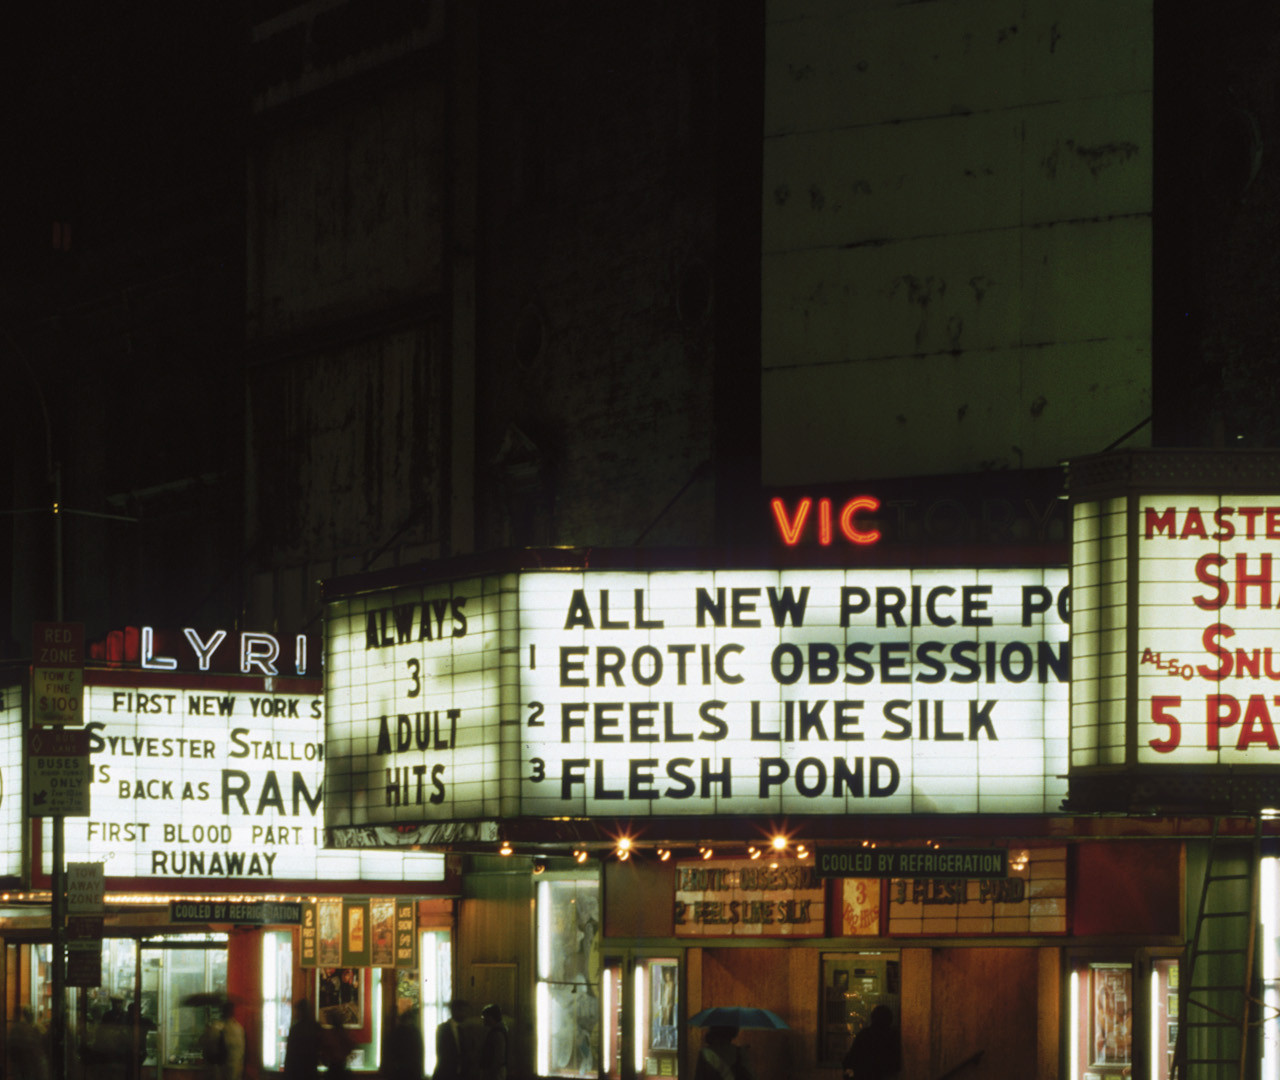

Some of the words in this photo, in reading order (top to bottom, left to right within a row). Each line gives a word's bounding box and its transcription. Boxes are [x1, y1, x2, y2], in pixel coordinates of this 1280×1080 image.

[564, 587, 665, 630] ALL
[695, 585, 811, 629] NEW
[840, 584, 994, 628] PRICE
[45, 629, 72, 643] RED
[367, 597, 468, 652] ALWAYS
[40, 649, 77, 663] ZONE
[529, 644, 536, 670] 1
[560, 644, 745, 687] EROTIC
[771, 641, 1069, 684] OBSESSION
[1140, 647, 1194, 682] ALSO
[42, 672, 63, 681] TOW
[46, 684, 70, 693] FINE
[406, 657, 421, 698] 3
[39, 697, 78, 711] $100
[112, 692, 175, 715] FIRST
[188, 693, 235, 717] NEW
[249, 696, 300, 719] YORK
[377, 708, 461, 757] ADULT
[527, 702, 544, 727] 2
[561, 701, 728, 743] FEELS
[750, 700, 864, 742] LIKE
[881, 699, 999, 741] SILK
[1149, 697, 1181, 753] 5
[86, 721, 215, 758] SYLVESTER
[38, 758, 79, 769] BUSES
[50, 778, 82, 787] ONLY
[386, 764, 447, 808] HITS
[528, 758, 545, 783] 3
[561, 758, 733, 801] FLESH
[759, 757, 900, 799] POND
[118, 780, 172, 800] BACK
[181, 782, 209, 801] AS
[221, 769, 323, 816] RAM
[87, 822, 148, 843] FIRST
[163, 823, 231, 844] BLOOD
[251, 825, 303, 845] PART
[76, 868, 96, 877] TOW
[151, 850, 277, 876] RUNAWAY
[822, 854, 872, 872] COOLED
[879, 854, 894, 871] BY
[900, 854, 1001, 872] REFRIGERATION
[70, 881, 99, 890] AWAY
[856, 882, 867, 905] 3
[896, 880, 906, 904] 3
[913, 879, 967, 905] FLESH
[980, 878, 1025, 904] POND
[70, 894, 101, 904] ZONE
[175, 904, 211, 919] COOLED
[214, 905, 226, 919] BY
[675, 901, 686, 924] 2
[694, 901, 739, 924] FEELS
[742, 901, 774, 923] LIKE
[777, 899, 811, 923] SILK
[305, 909, 312, 927] 2
